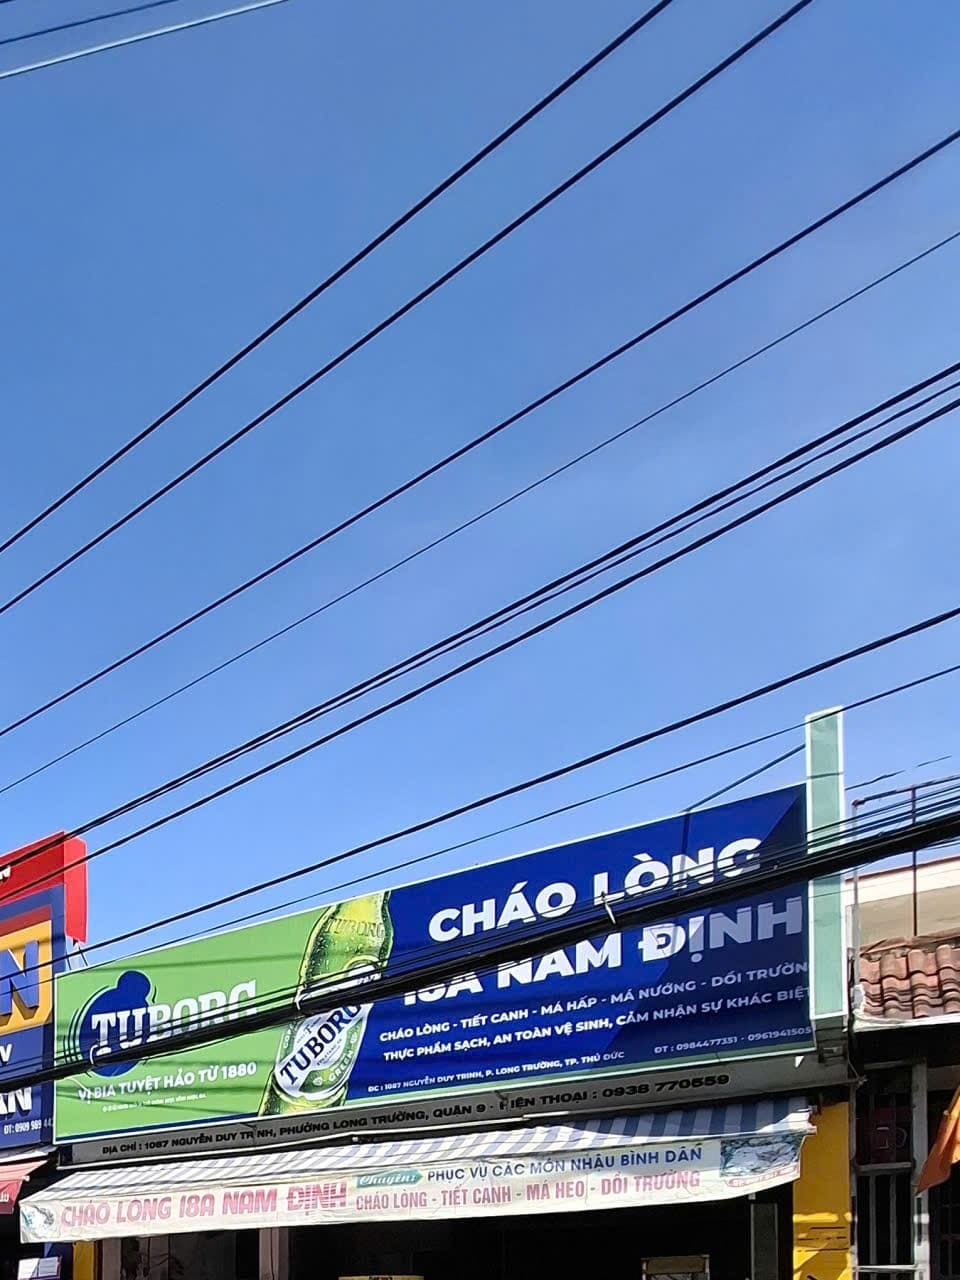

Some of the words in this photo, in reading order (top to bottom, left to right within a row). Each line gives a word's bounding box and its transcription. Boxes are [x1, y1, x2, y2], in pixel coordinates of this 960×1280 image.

[428, 881, 577, 942] CHÁO
[593, 837, 762, 906] LÒNG
[497, 932, 622, 989] NAM
[637, 896, 803, 963] ĐỊNH
[92, 980, 258, 1057] TUBORG
[380, 1026, 414, 1042] CHÁO
[416, 1020, 450, 1035] LÒNG
[460, 1013, 488, 1029] TIẾT
[490, 1009, 528, 1024] CANH
[541, 1001, 564, 1016] MÁ
[566, 995, 598, 1011] HẤP
[610, 989, 635, 1005] MÁ
[383, 1047, 415, 1062] THỰC
[453, 1036, 491, 1052] SẠCH,
[493, 1033, 513, 1045] AN
[515, 1026, 552, 1042] TOÀN
[553, 1022, 573, 1037] VỆ
[575, 1016, 613, 1032] SINH,
[652, 1003, 698, 1020] NHẬN
[701, 999, 724, 1014] SỰ
[726, 991, 773, 1009] KHÁC
[94, 1085, 116, 1099] BIA
[118, 1076, 162, 1096] TUYỆT
[164, 1070, 195, 1087] HẢO
[198, 1065, 218, 1082] TỪ
[222, 1062, 257, 1079] 1880
[329, 1050, 354, 1082] GREEN
[437, 1075, 455, 1084] DUY
[495, 1066, 520, 1076] LONG
[564, 1057, 580, 1066] TP.
[102, 1145, 118, 1155] ĐỊA
[120, 1141, 137, 1153] CHỈ
[215, 1132, 239, 1142] DUY
[240, 1128, 277, 1141] TRNH,
[333, 1117, 368, 1131] LONG
[371, 1110, 429, 1126] TRƯỜNG,
[475, 1103, 486, 1113] 9
[540, 1091, 588, 1106] THOẠI
[602, 1083, 650, 1098] 0938
[655, 1074, 730, 1092] 770559
[427, 1168, 465, 1185] PHỤC
[470, 1164, 488, 1182] VỤ
[492, 1160, 526, 1176] CÁC
[529, 1157, 565, 1174] MÓN
[570, 1153, 615, 1172] NHẬU
[620, 1150, 659, 1166] BÌNH
[61, 1199, 110, 1227] CHÁO
[179, 1193, 216, 1218] 18A
[222, 1187, 278, 1215] NAM
[286, 1181, 347, 1216] ĐỊNH
[356, 1188, 389, 1211] CHÁO
[393, 1188, 427, 1209] LÒNG
[441, 1184, 469, 1206] TIẾT
[473, 1185, 511, 1204] CANH
[526, 1180, 550, 1201] MÁ
[555, 1180, 585, 1199] HEO
